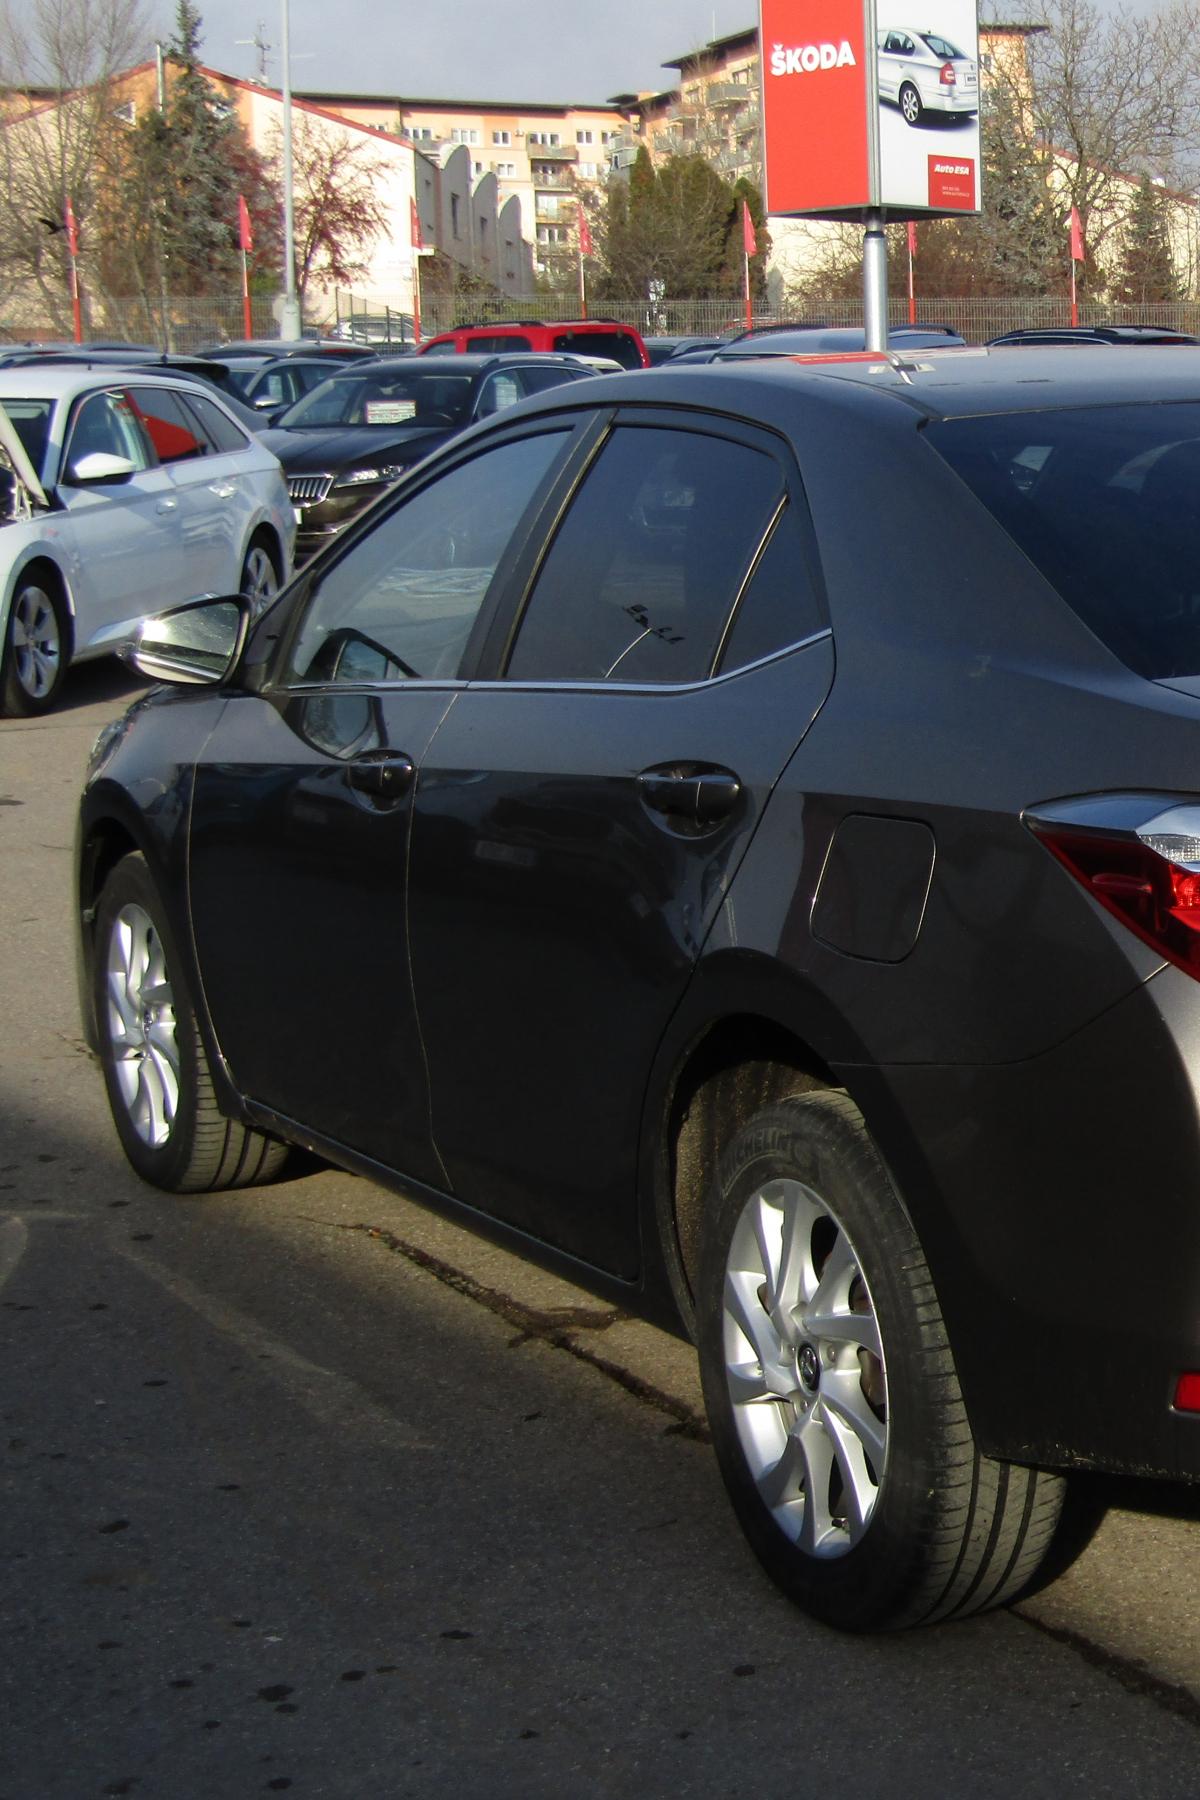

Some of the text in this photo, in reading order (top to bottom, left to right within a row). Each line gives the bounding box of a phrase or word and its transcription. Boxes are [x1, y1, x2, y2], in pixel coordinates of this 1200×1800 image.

[771, 41, 856, 77] ŠKODA
[934, 164, 970, 176] Auto ESA
